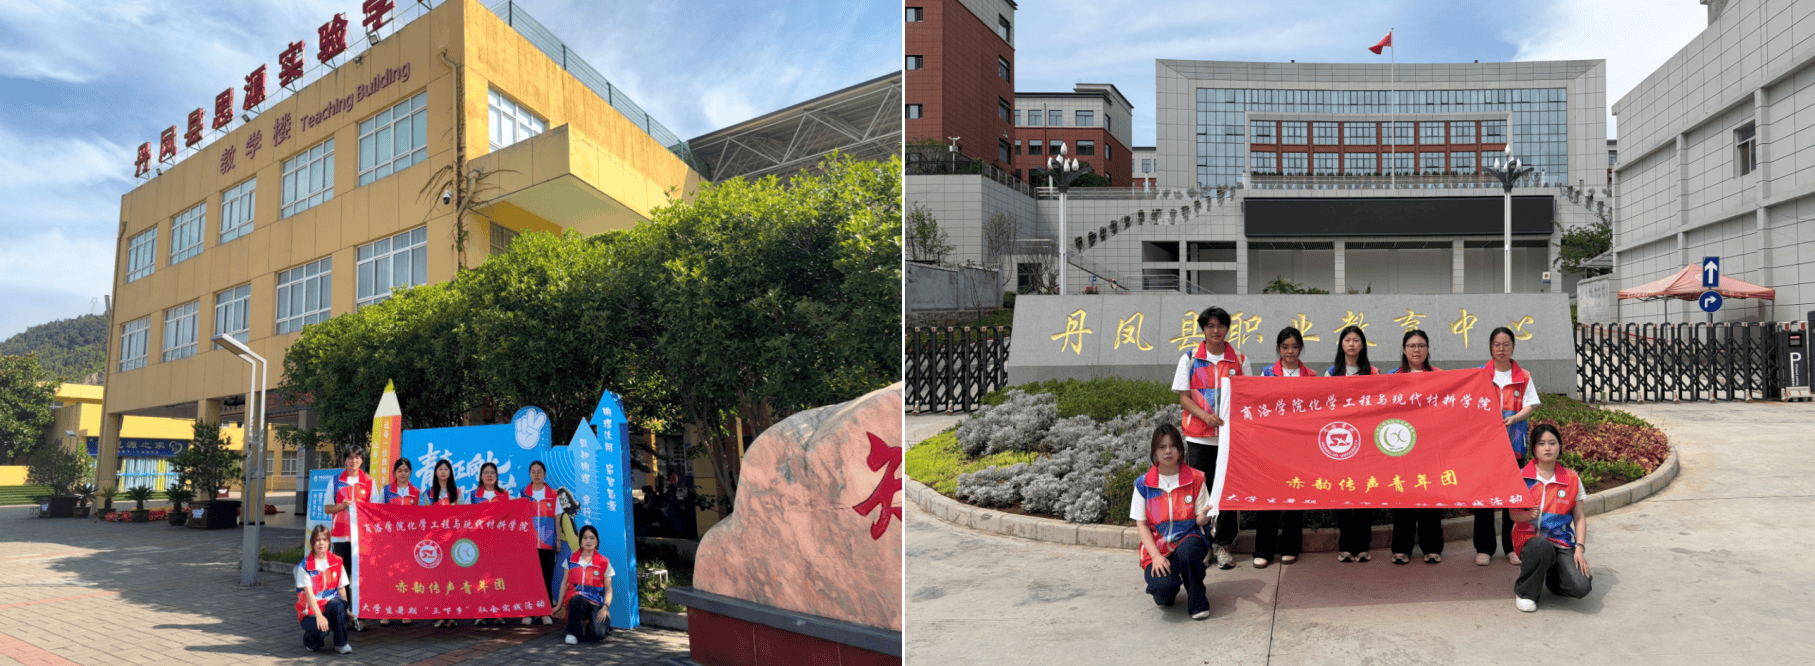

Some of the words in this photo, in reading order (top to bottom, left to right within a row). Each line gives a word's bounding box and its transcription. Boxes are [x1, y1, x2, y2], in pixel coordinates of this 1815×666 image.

[134, 0, 424, 178] 丹凤县思源实验学
[219, 112, 292, 175] 教学楼
[300, 94, 354, 132] Teaching
[355, 62, 411, 103] Building
[1240, 391, 1492, 420] 商洛学院化学工程与现代材料学院
[119, 441, 166, 449] 源之家
[1286, 470, 1457, 493] 赤韵传声青年团
